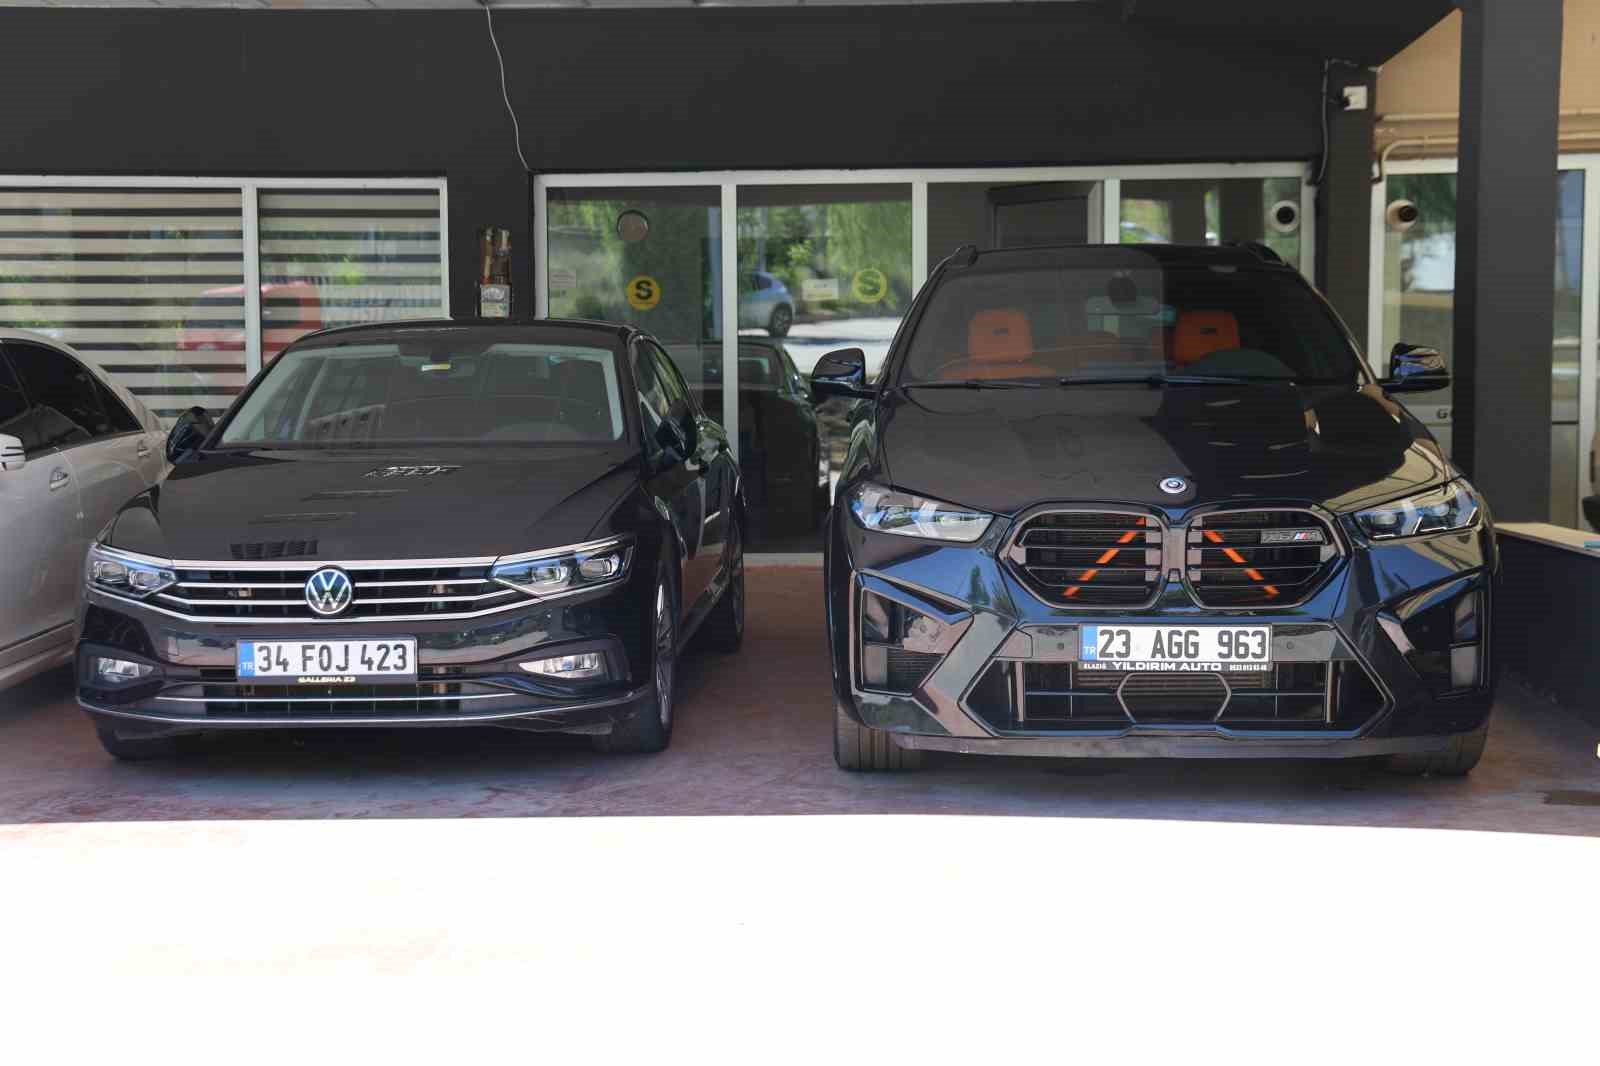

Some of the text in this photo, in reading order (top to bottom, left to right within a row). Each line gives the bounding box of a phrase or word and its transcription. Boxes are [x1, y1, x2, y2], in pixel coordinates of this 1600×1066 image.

[635, 280, 653, 300] S
[1083, 646, 1096, 656] TR
[1099, 629, 1267, 660] 23 AGG 963
[257, 643, 408, 673] 34 FOJ 423
[240, 662, 255, 672] TR
[1112, 661, 1176, 671] YILDIRIM
[1179, 661, 1222, 671] AUTO
